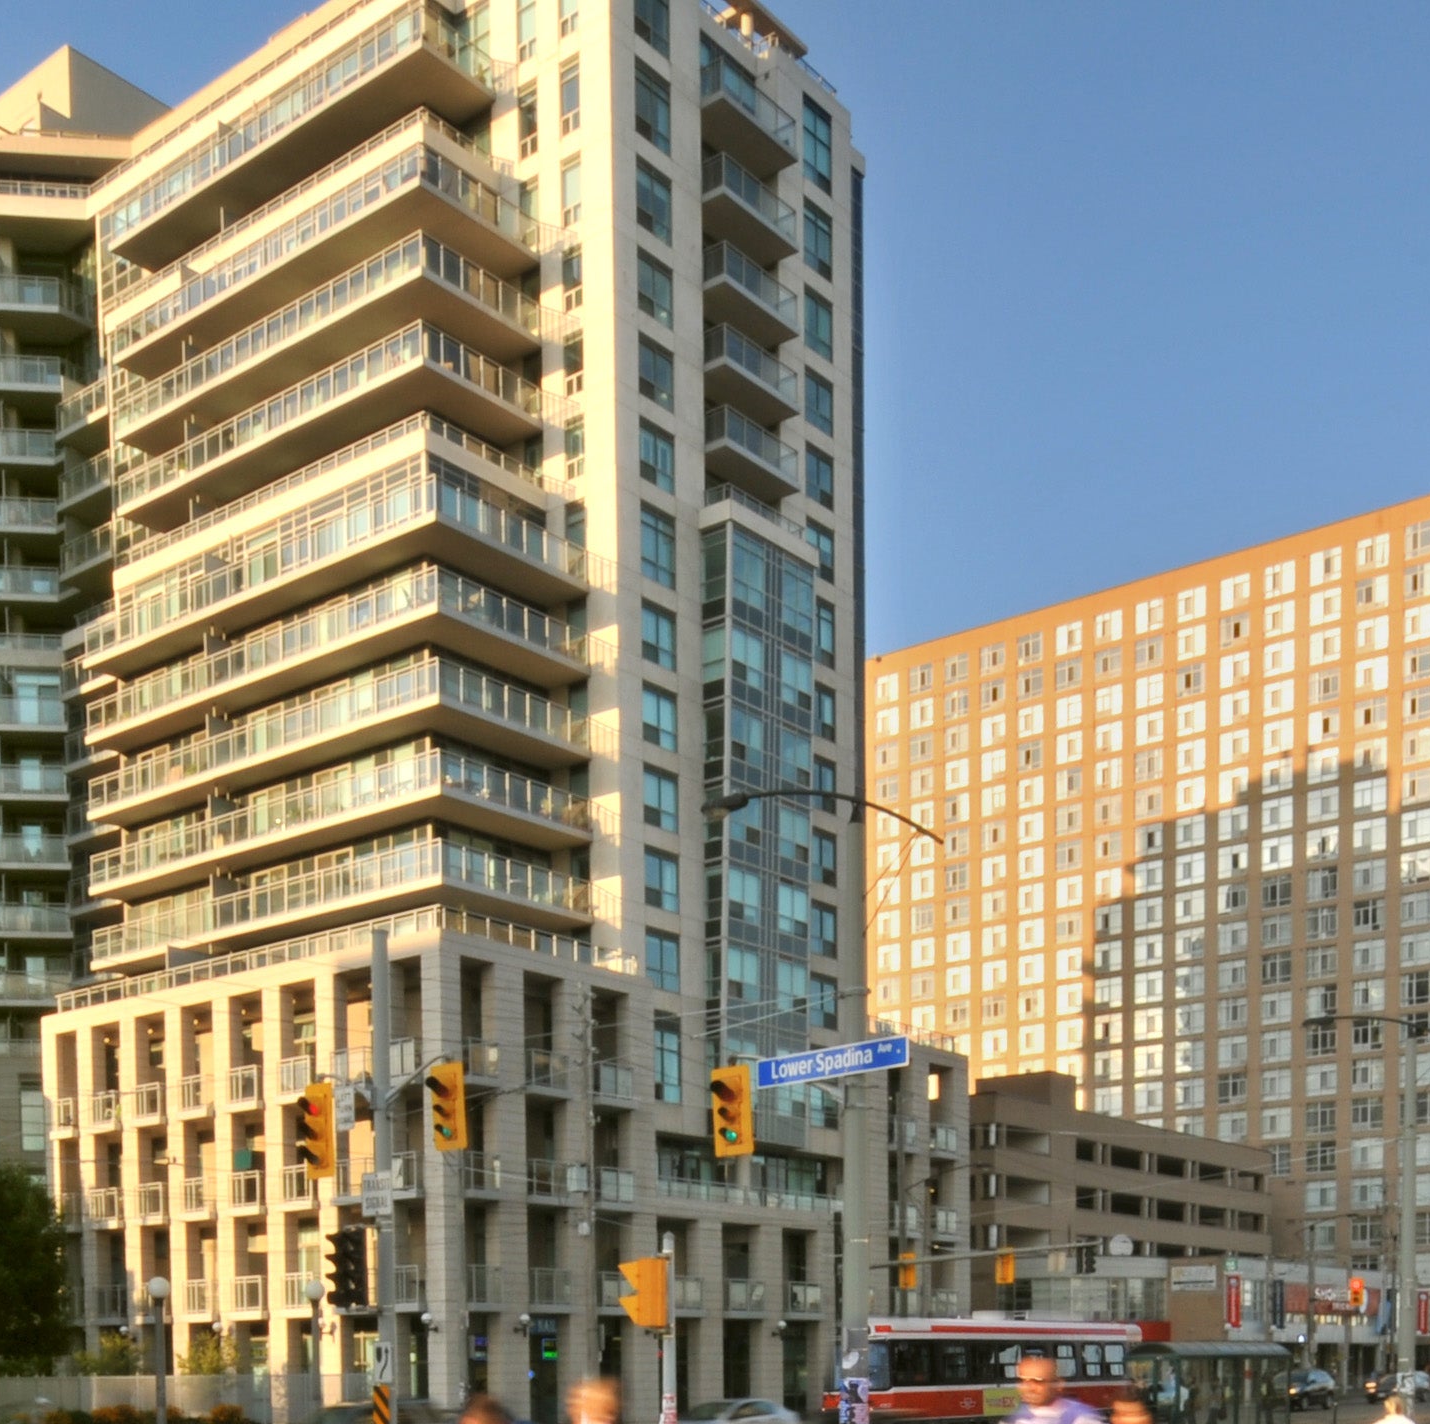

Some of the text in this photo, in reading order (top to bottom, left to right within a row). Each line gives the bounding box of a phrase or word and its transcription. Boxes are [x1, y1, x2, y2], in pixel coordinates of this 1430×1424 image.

[771, 1043, 893, 1080] Lower Spadina Ave
